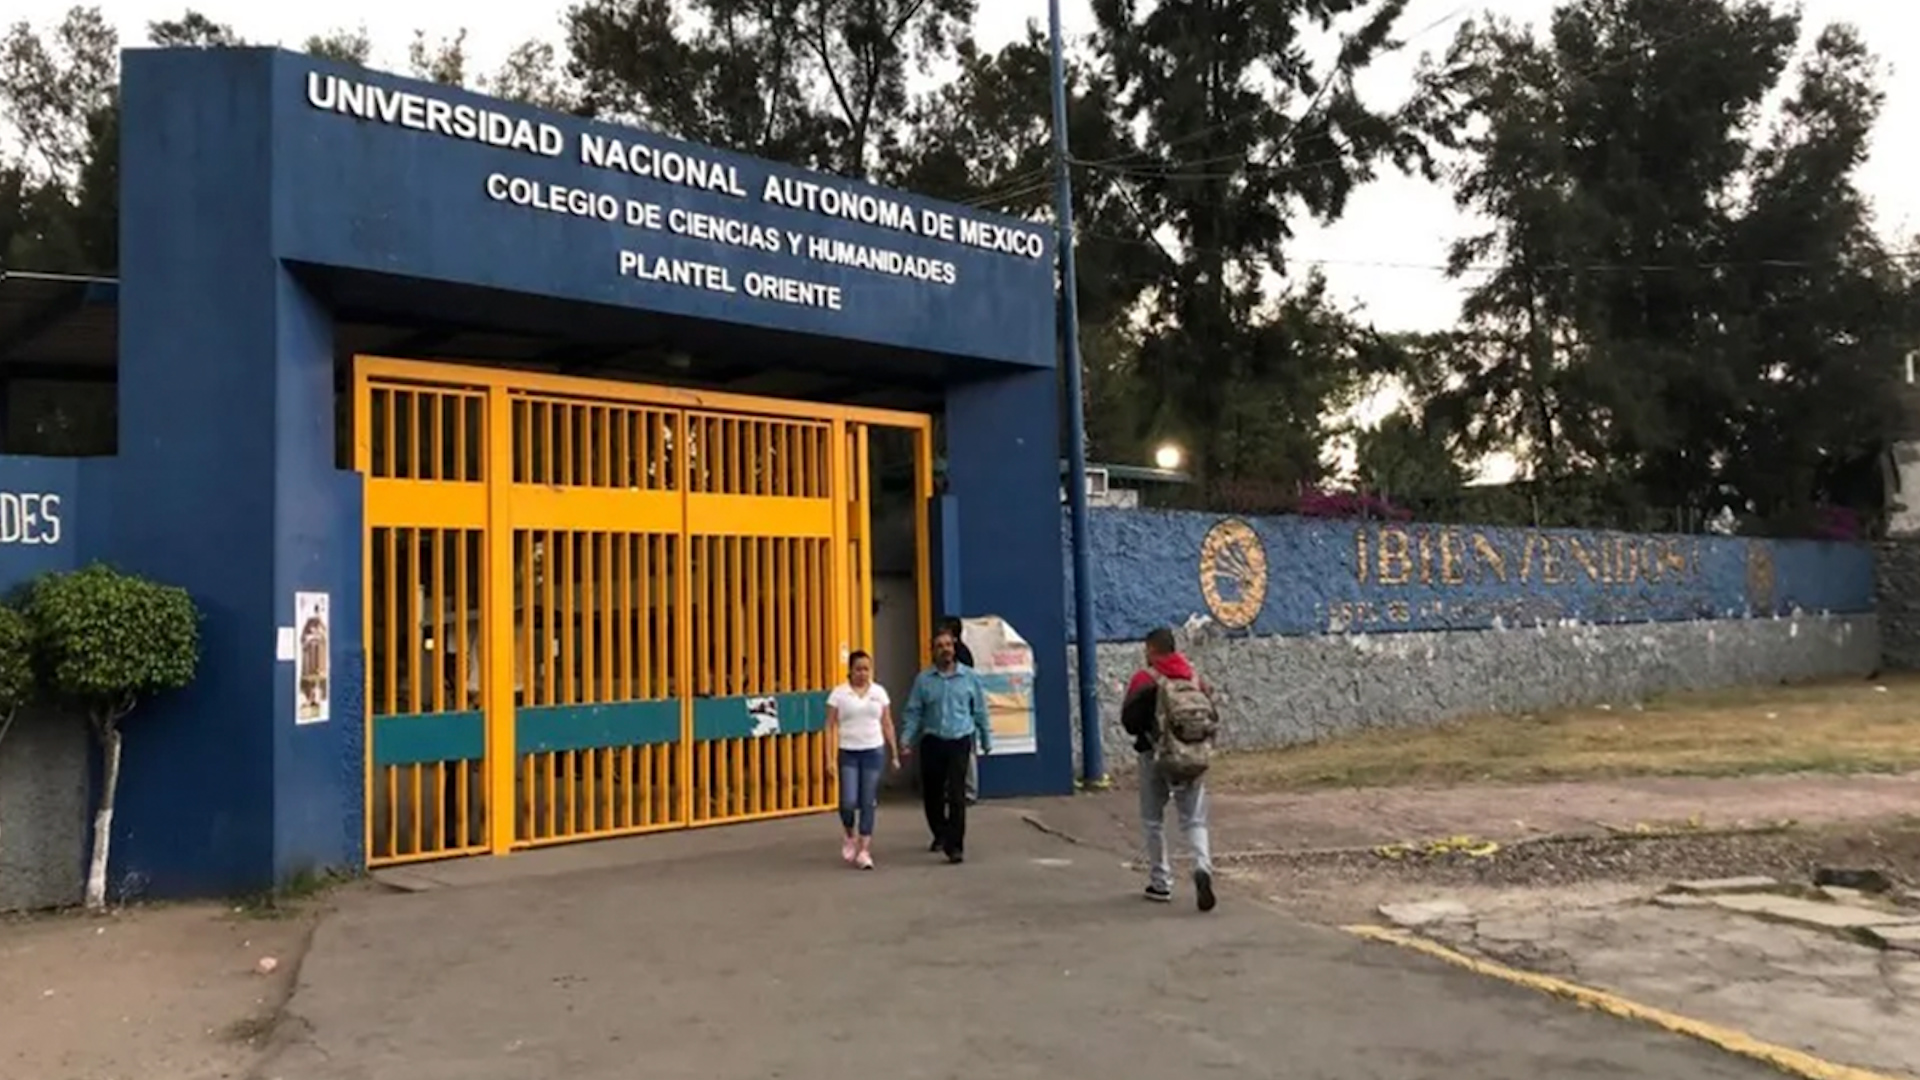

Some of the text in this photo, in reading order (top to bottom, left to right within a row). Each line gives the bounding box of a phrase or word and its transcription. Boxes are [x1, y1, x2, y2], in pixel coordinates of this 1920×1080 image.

[308, 71, 1044, 258] UNIVERSIDAD NACIONAL AUTONOMA DE MEXICO
[487, 173, 956, 285] COLEGIO DE CIENCIAS Y HUMANIDADES
[619, 250, 842, 310] PLANTEL ORIENTE
[0, 493, 61, 544] DES
